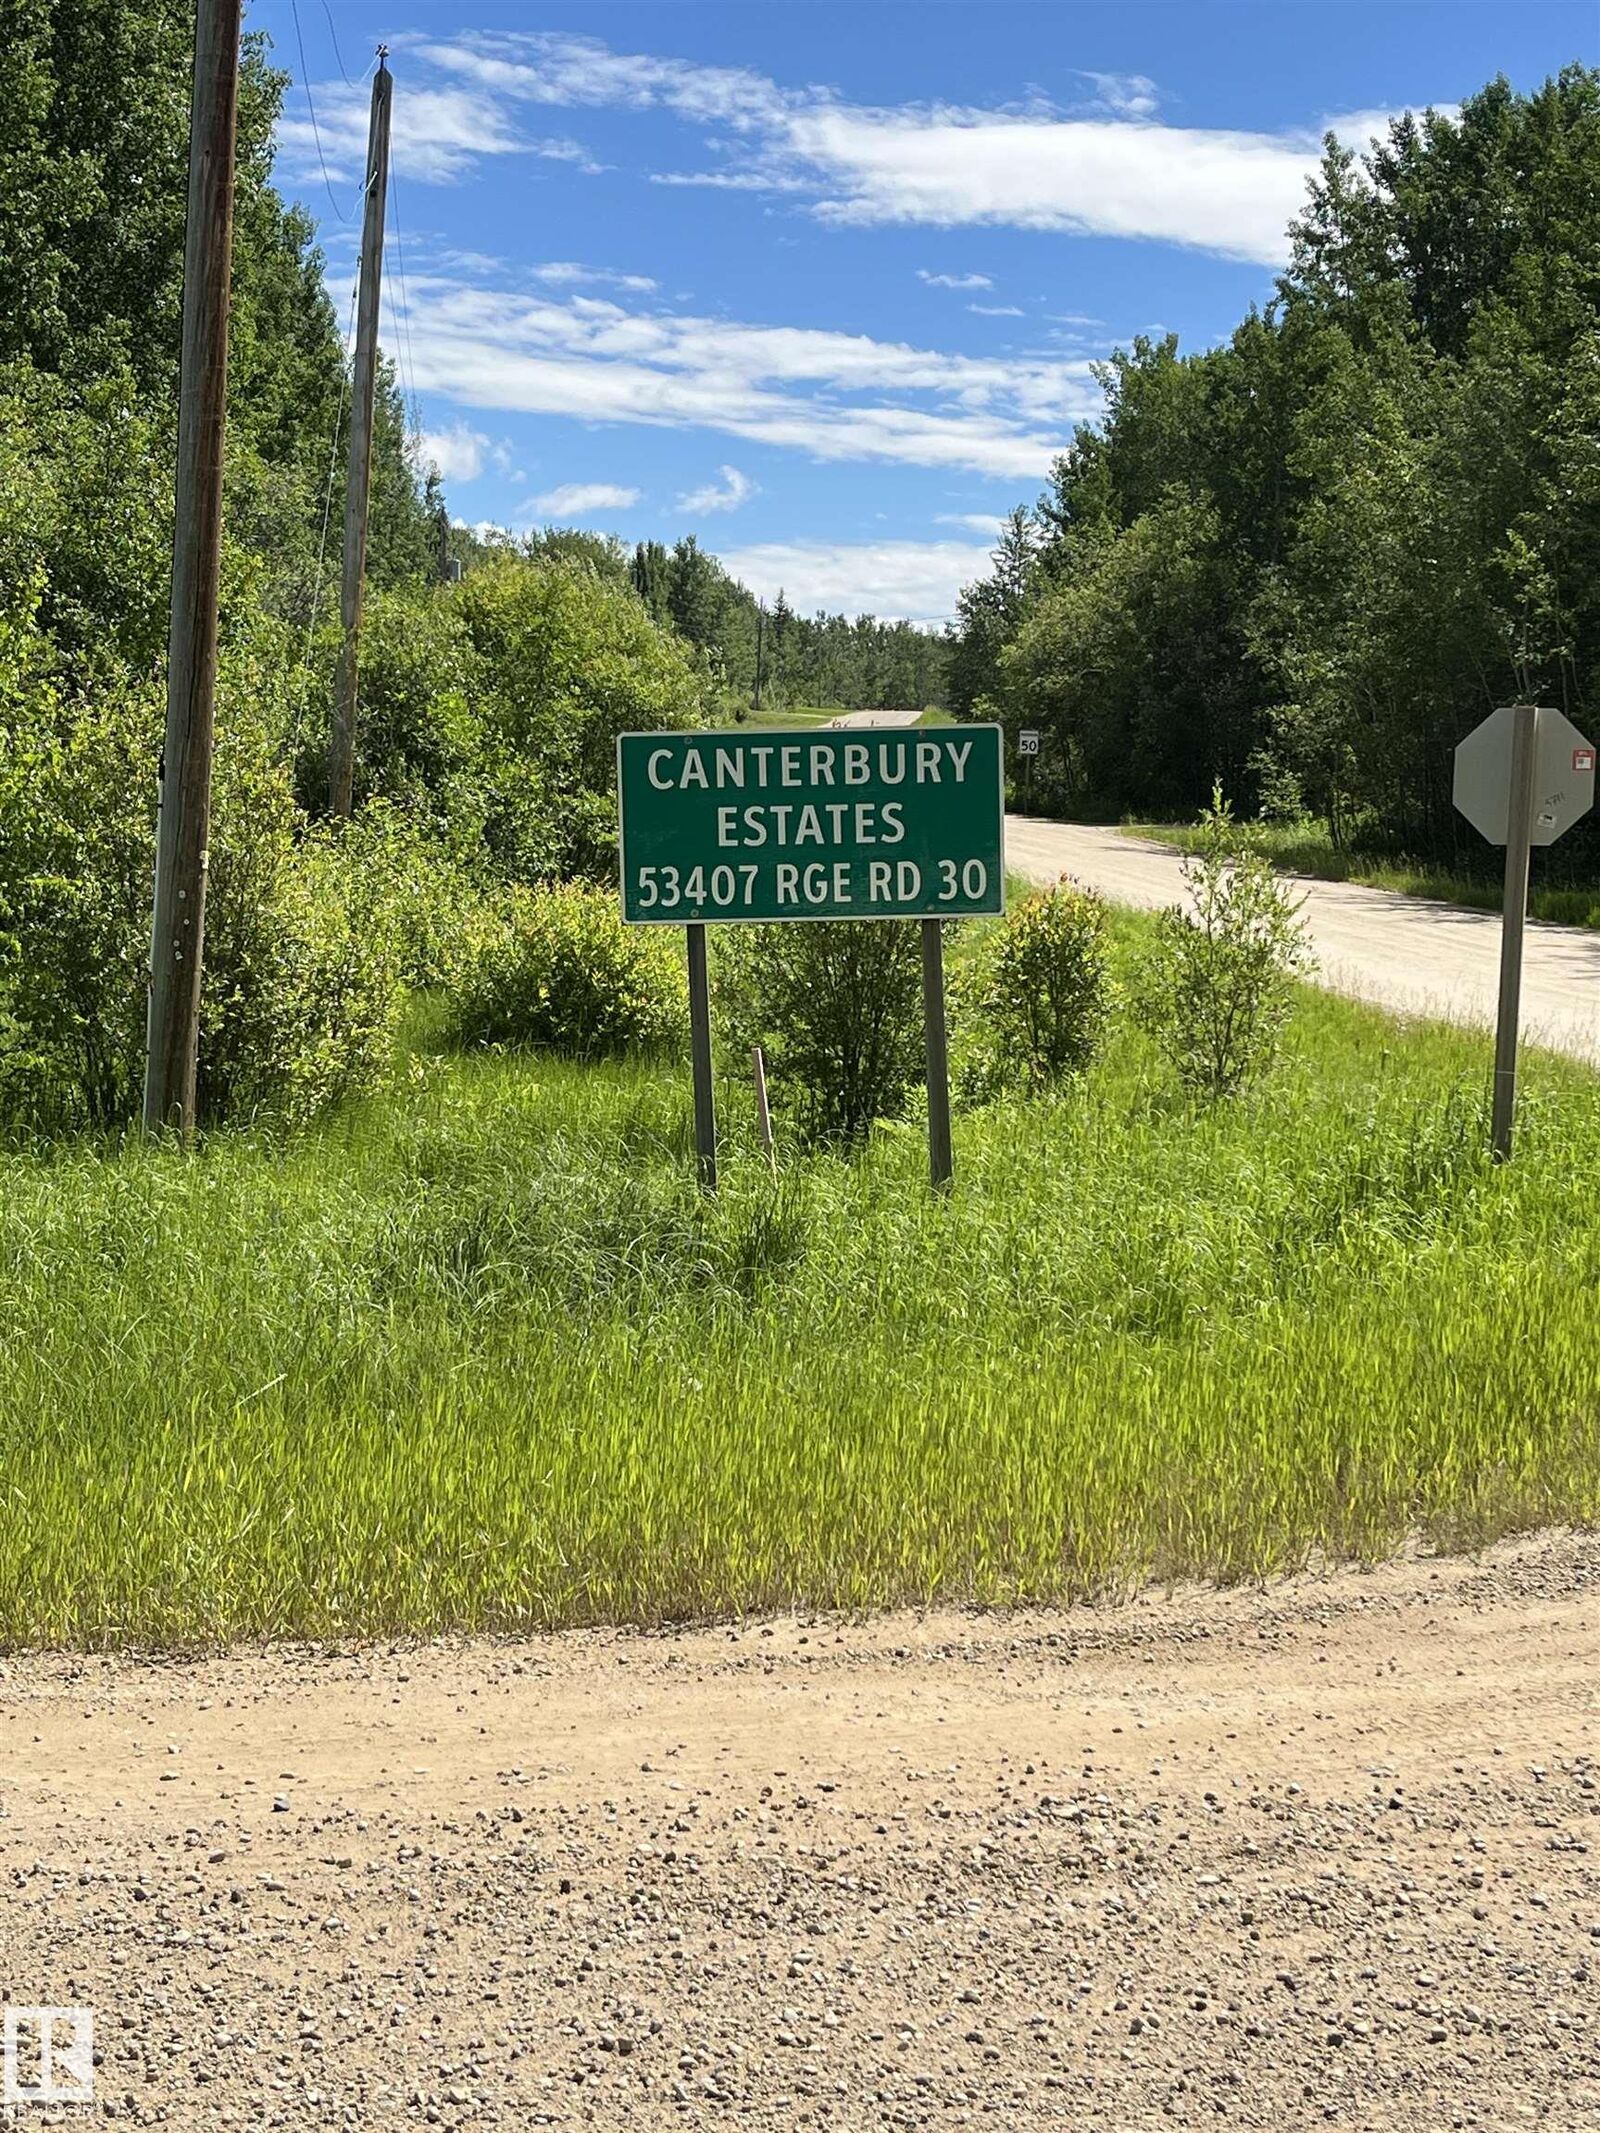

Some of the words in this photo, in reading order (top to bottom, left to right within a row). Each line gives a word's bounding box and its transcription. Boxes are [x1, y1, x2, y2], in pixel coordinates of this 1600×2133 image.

[647, 741, 974, 790] CANTERBURY
[1021, 740, 1037, 752] 50
[717, 802, 906, 847] ESTATES
[638, 865, 759, 908] 53407
[776, 862, 852, 904] RGE
[869, 860, 921, 902] RD
[937, 858, 987, 901] 30
